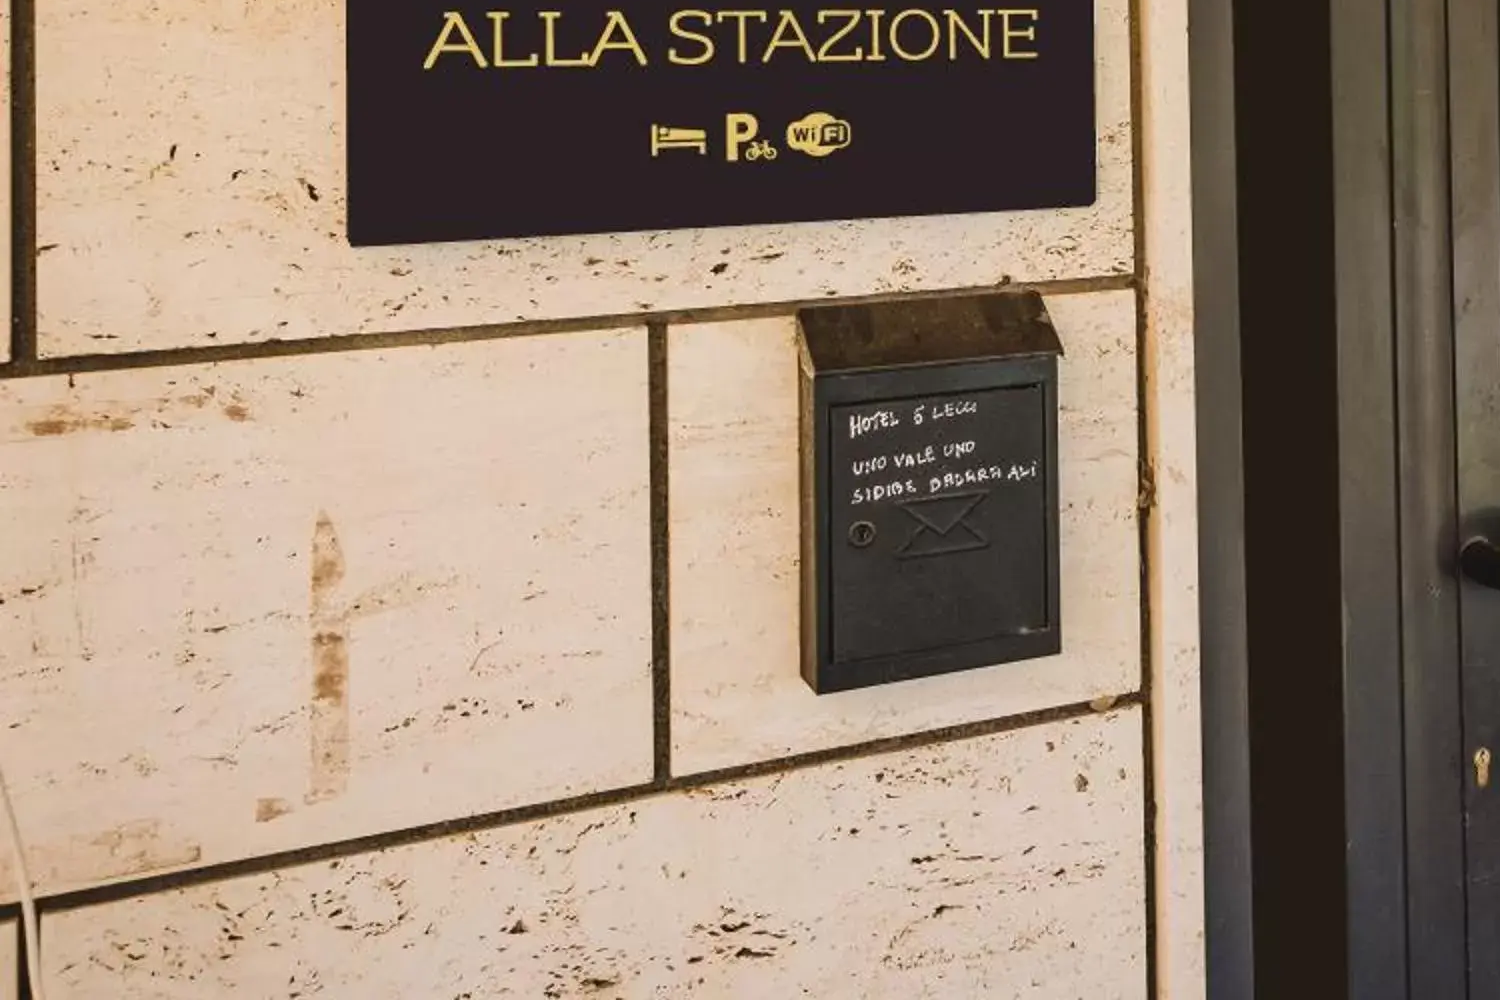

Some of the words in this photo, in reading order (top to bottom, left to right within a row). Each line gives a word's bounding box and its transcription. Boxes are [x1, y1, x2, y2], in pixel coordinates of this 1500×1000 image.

[423, 10, 648, 70] ALLA
[668, 8, 1039, 65] STAZIONE
[726, 112, 758, 162] P
[849, 410, 899, 439] HOTEL
[852, 455, 888, 475] UNO
[943, 441, 976, 458] UNO
